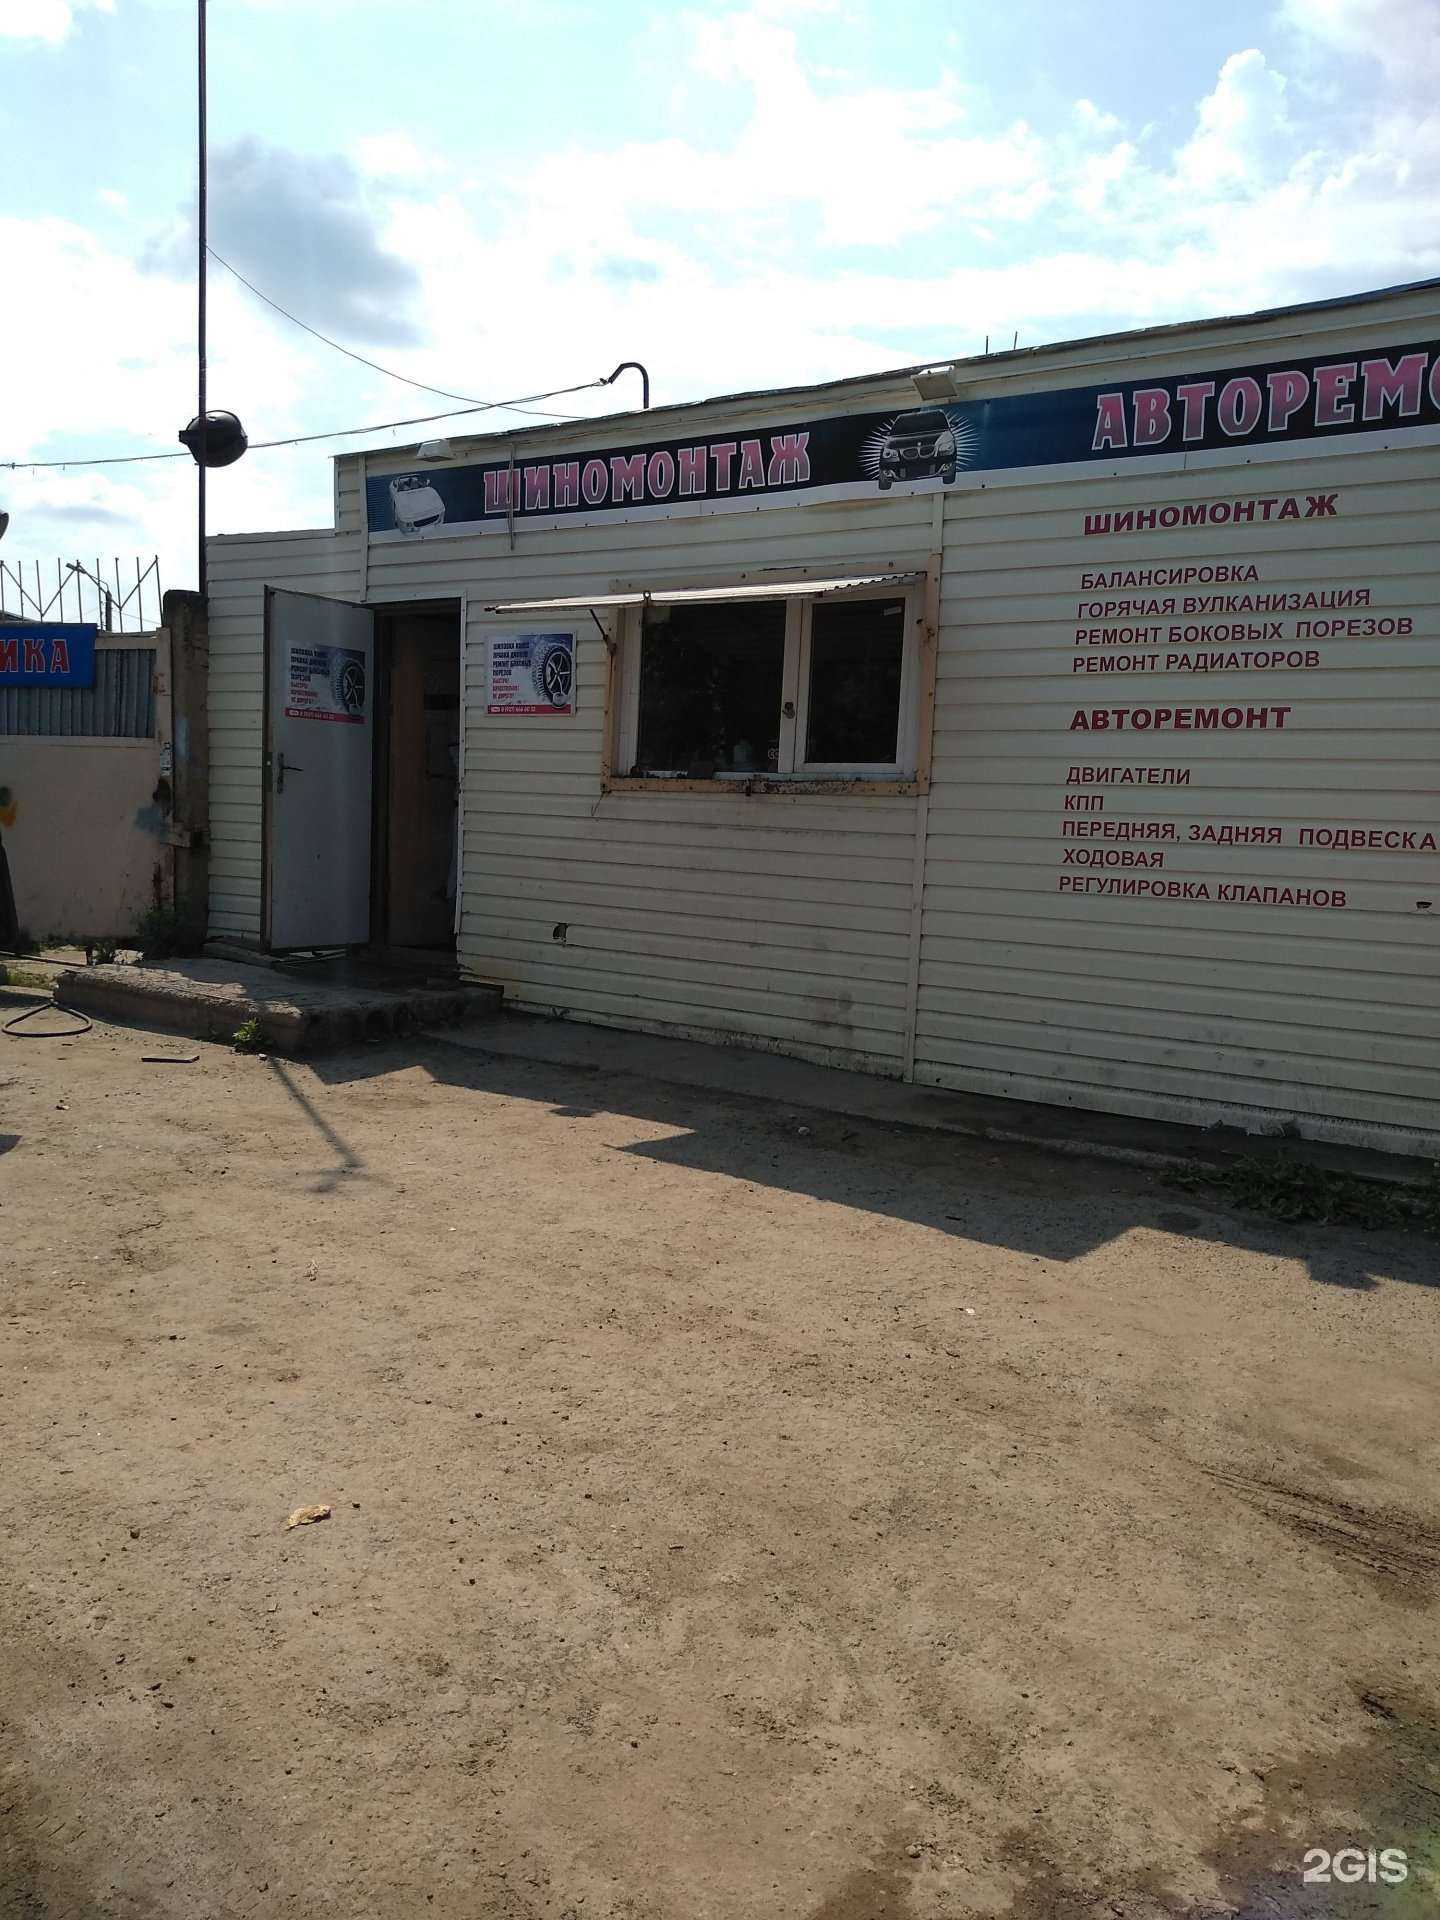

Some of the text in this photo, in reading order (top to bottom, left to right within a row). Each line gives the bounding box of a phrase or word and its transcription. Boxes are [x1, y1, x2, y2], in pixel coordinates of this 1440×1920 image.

[1091, 352, 1440, 451] АВТОРЕМ
[483, 431, 811, 514] ШИНОМОНТАЖ
[1083, 493, 1339, 536] ШИНОМОНТАЖ
[1081, 564, 1259, 590] БАЛАНСИРОВКА
[1077, 588, 1371, 619] ГОРЯЧАЯ ВУЛКАНИЗАЦИЯ
[1075, 617, 1413, 646] РЕМОНТ БОКОВЫХ ПОРЕЗОВ
[1072, 650, 1320, 673] РЕМОНТ РАДИАТОРОВ
[1070, 706, 1292, 731] АВТОРЕМОНТ
[1066, 766, 1191, 785] ДВИГАТЕЛИ
[1064, 794, 1104, 811] КПП
[1062, 820, 1438, 851] ПЕРЕДНЯЯ, ЗАДНЯЯ ПОДВЕСКА
[1062, 848, 1164, 868] ХОДОВАЯ
[1059, 876, 1346, 907] РЕГУЛИРОВКА КЛАПАНОВ
